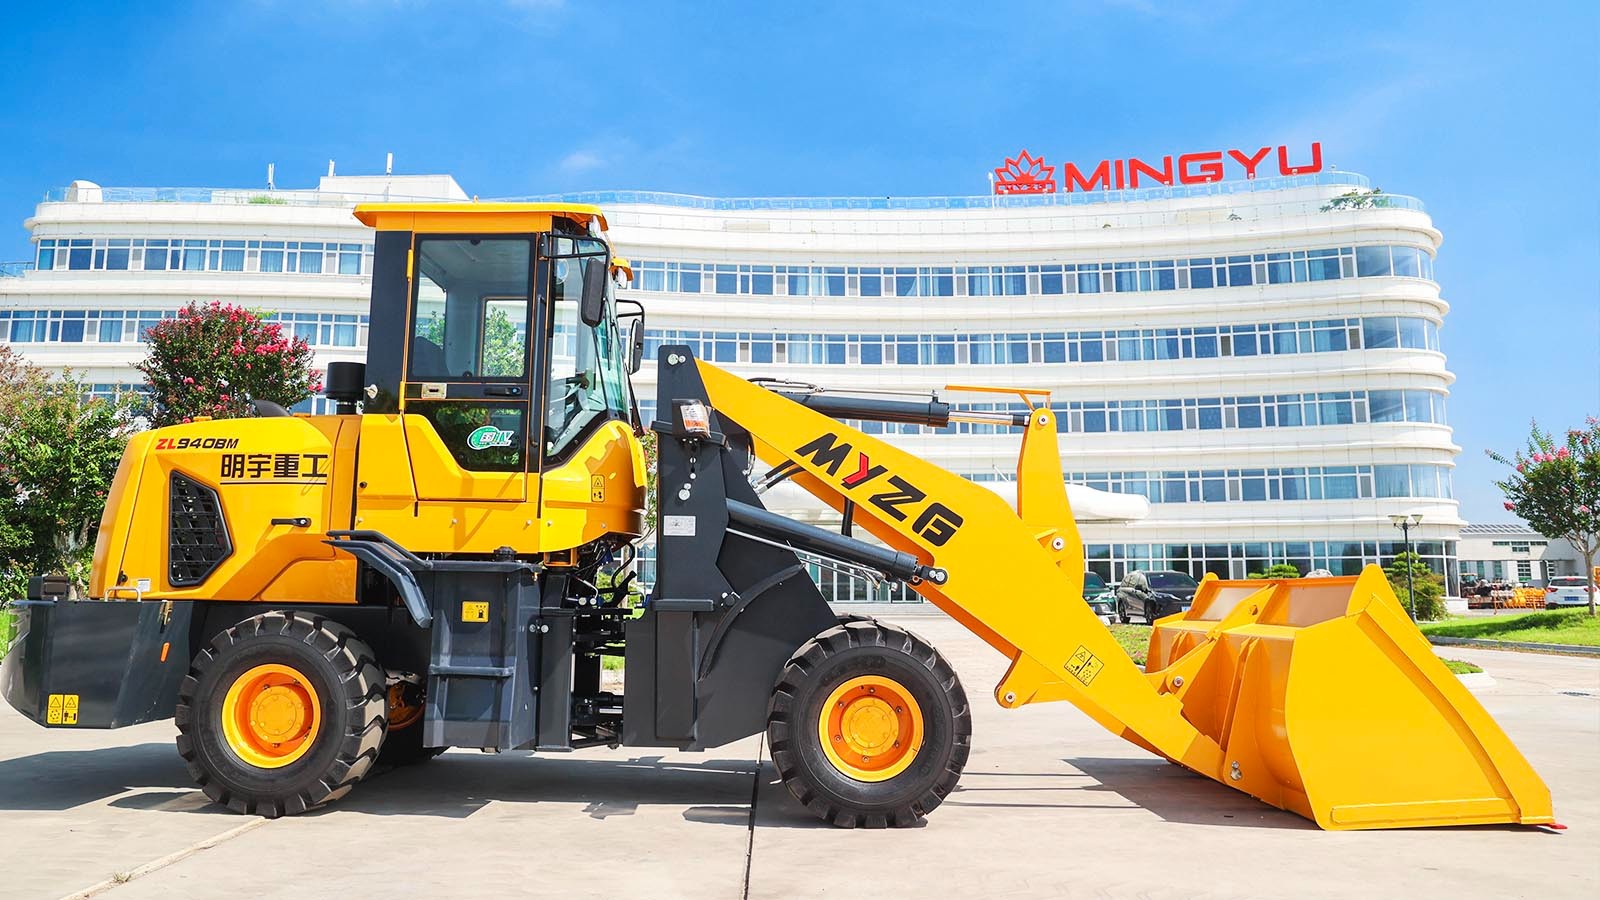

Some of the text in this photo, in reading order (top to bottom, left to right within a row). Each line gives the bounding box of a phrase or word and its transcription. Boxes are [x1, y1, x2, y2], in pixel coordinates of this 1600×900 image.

[1064, 142, 1323, 192] MINGYU
[155, 438, 239, 450] ZL940BM
[220, 454, 328, 479] 明宇重工
[794, 432, 964, 547] MYZG
